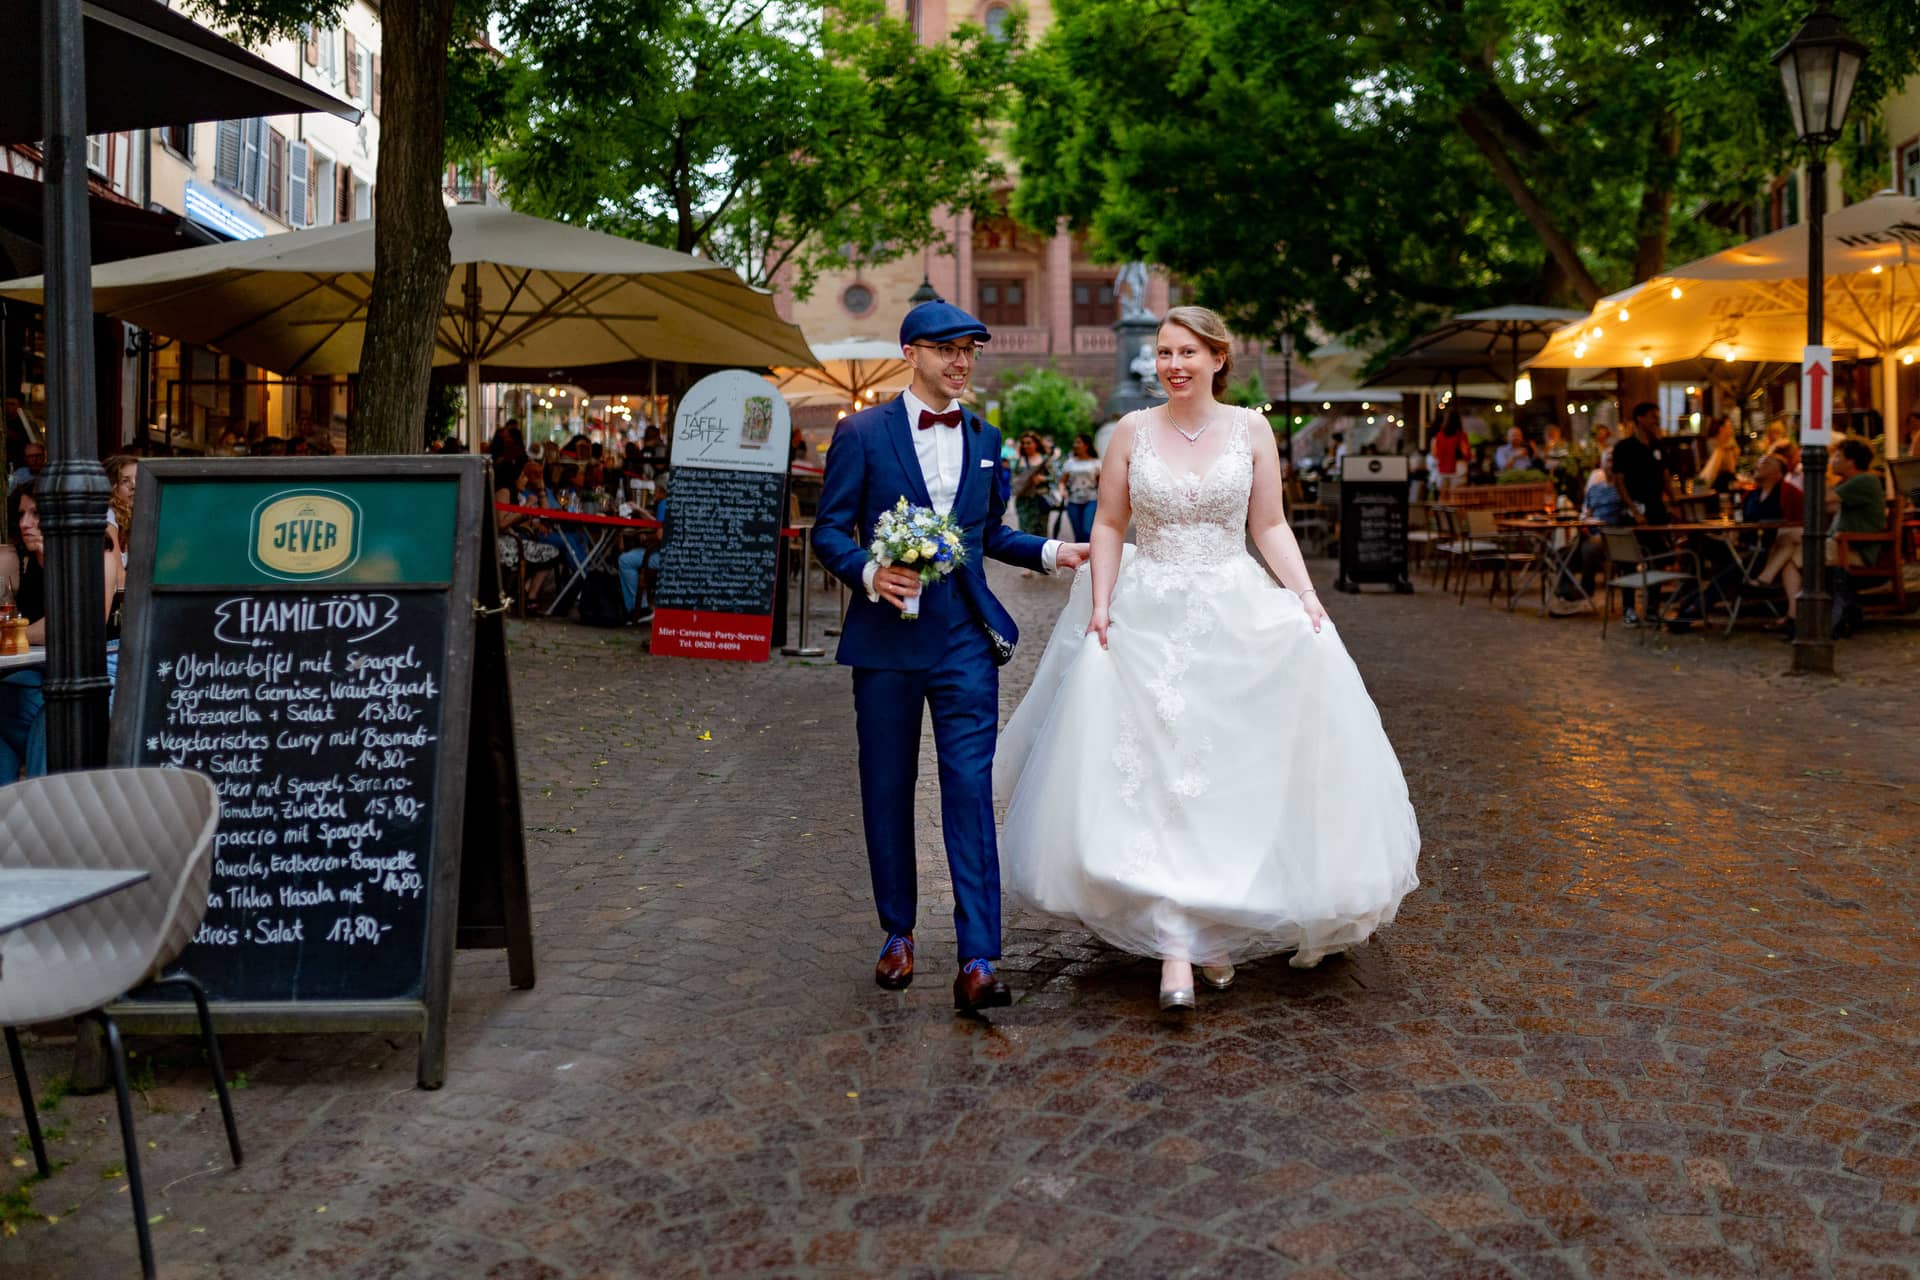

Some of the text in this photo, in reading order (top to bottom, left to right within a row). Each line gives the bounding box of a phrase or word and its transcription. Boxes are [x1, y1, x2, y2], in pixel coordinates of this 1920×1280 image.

[679, 429, 726, 443] SPITZ
[682, 414, 729, 430] TAFEL
[273, 519, 338, 552] JEVER
[175, 645, 422, 688] Ofenkartoffel mit Spargel,
[166, 683, 251, 709] gegrilltem
[254, 680, 328, 702] Gemüse,
[287, 703, 336, 722] Salat
[160, 729, 269, 765] Vegetarisches
[276, 730, 324, 755] Curry
[329, 727, 359, 747] mit
[209, 753, 263, 774] Salat
[256, 774, 281, 798] mit
[287, 773, 345, 802] Spargel,
[280, 798, 347, 820] Zwiebel
[283, 824, 309, 844] mit
[316, 819, 383, 849] Spargel,
[226, 885, 273, 909] Tikka
[280, 881, 336, 908] Masala
[340, 882, 364, 904] mit
[254, 918, 305, 945] Salat
